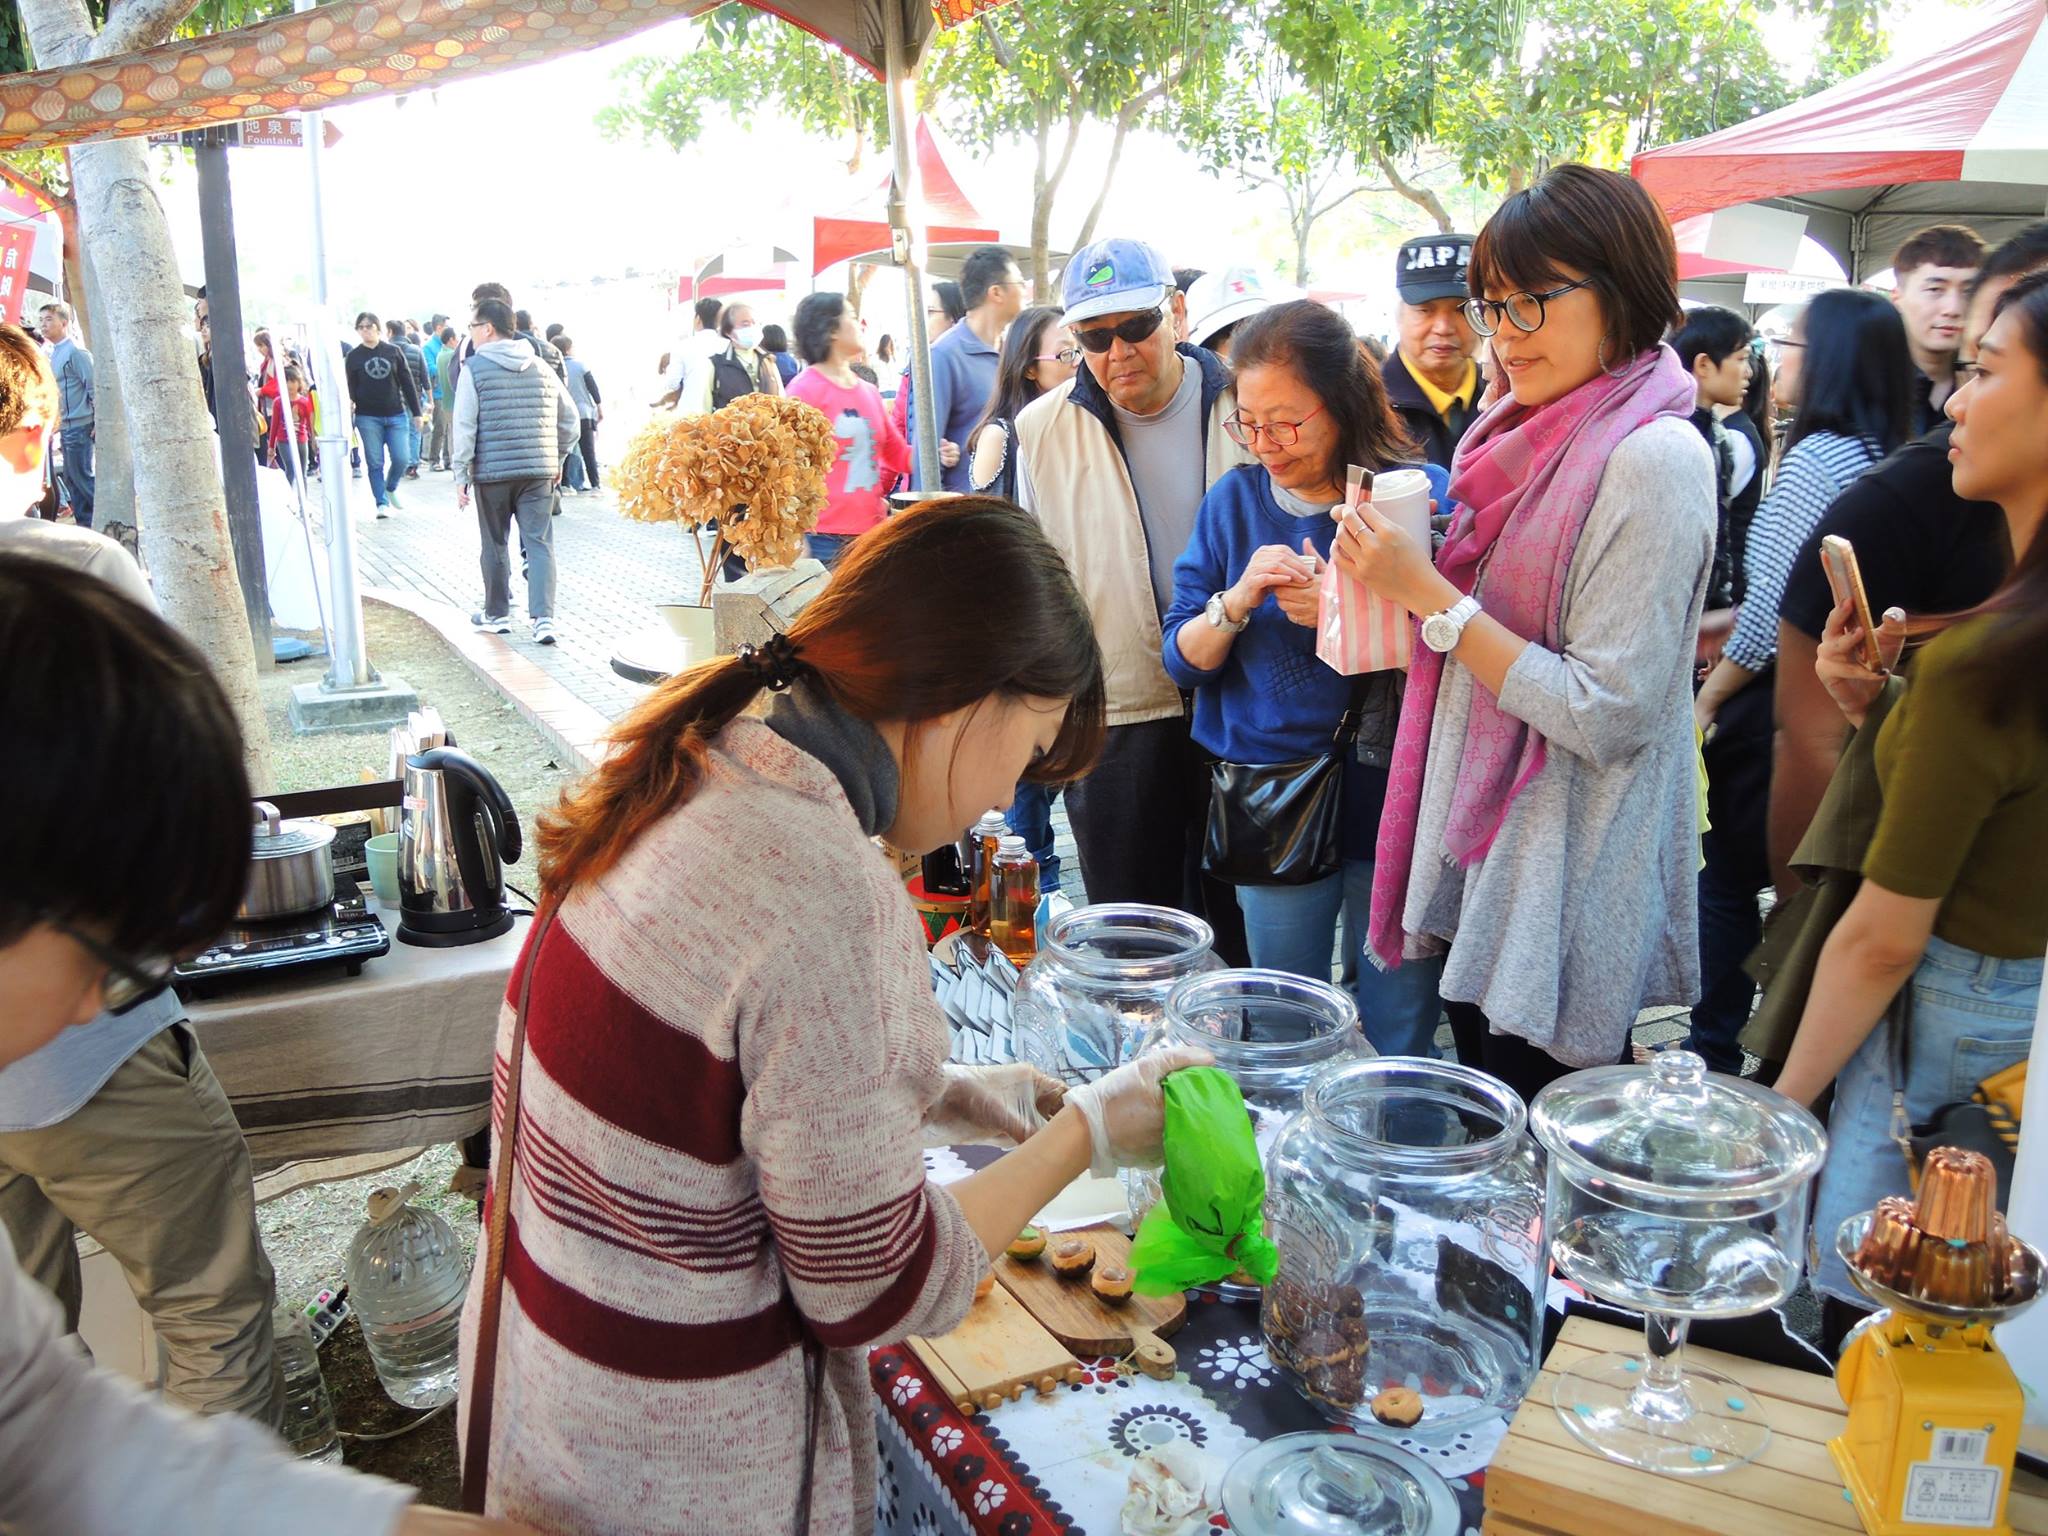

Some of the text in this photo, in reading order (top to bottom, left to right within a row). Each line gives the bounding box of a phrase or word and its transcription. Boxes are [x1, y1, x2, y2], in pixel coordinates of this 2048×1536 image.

[245, 120, 326, 136] 地泉廣
[247, 135, 293, 145] Fountain
